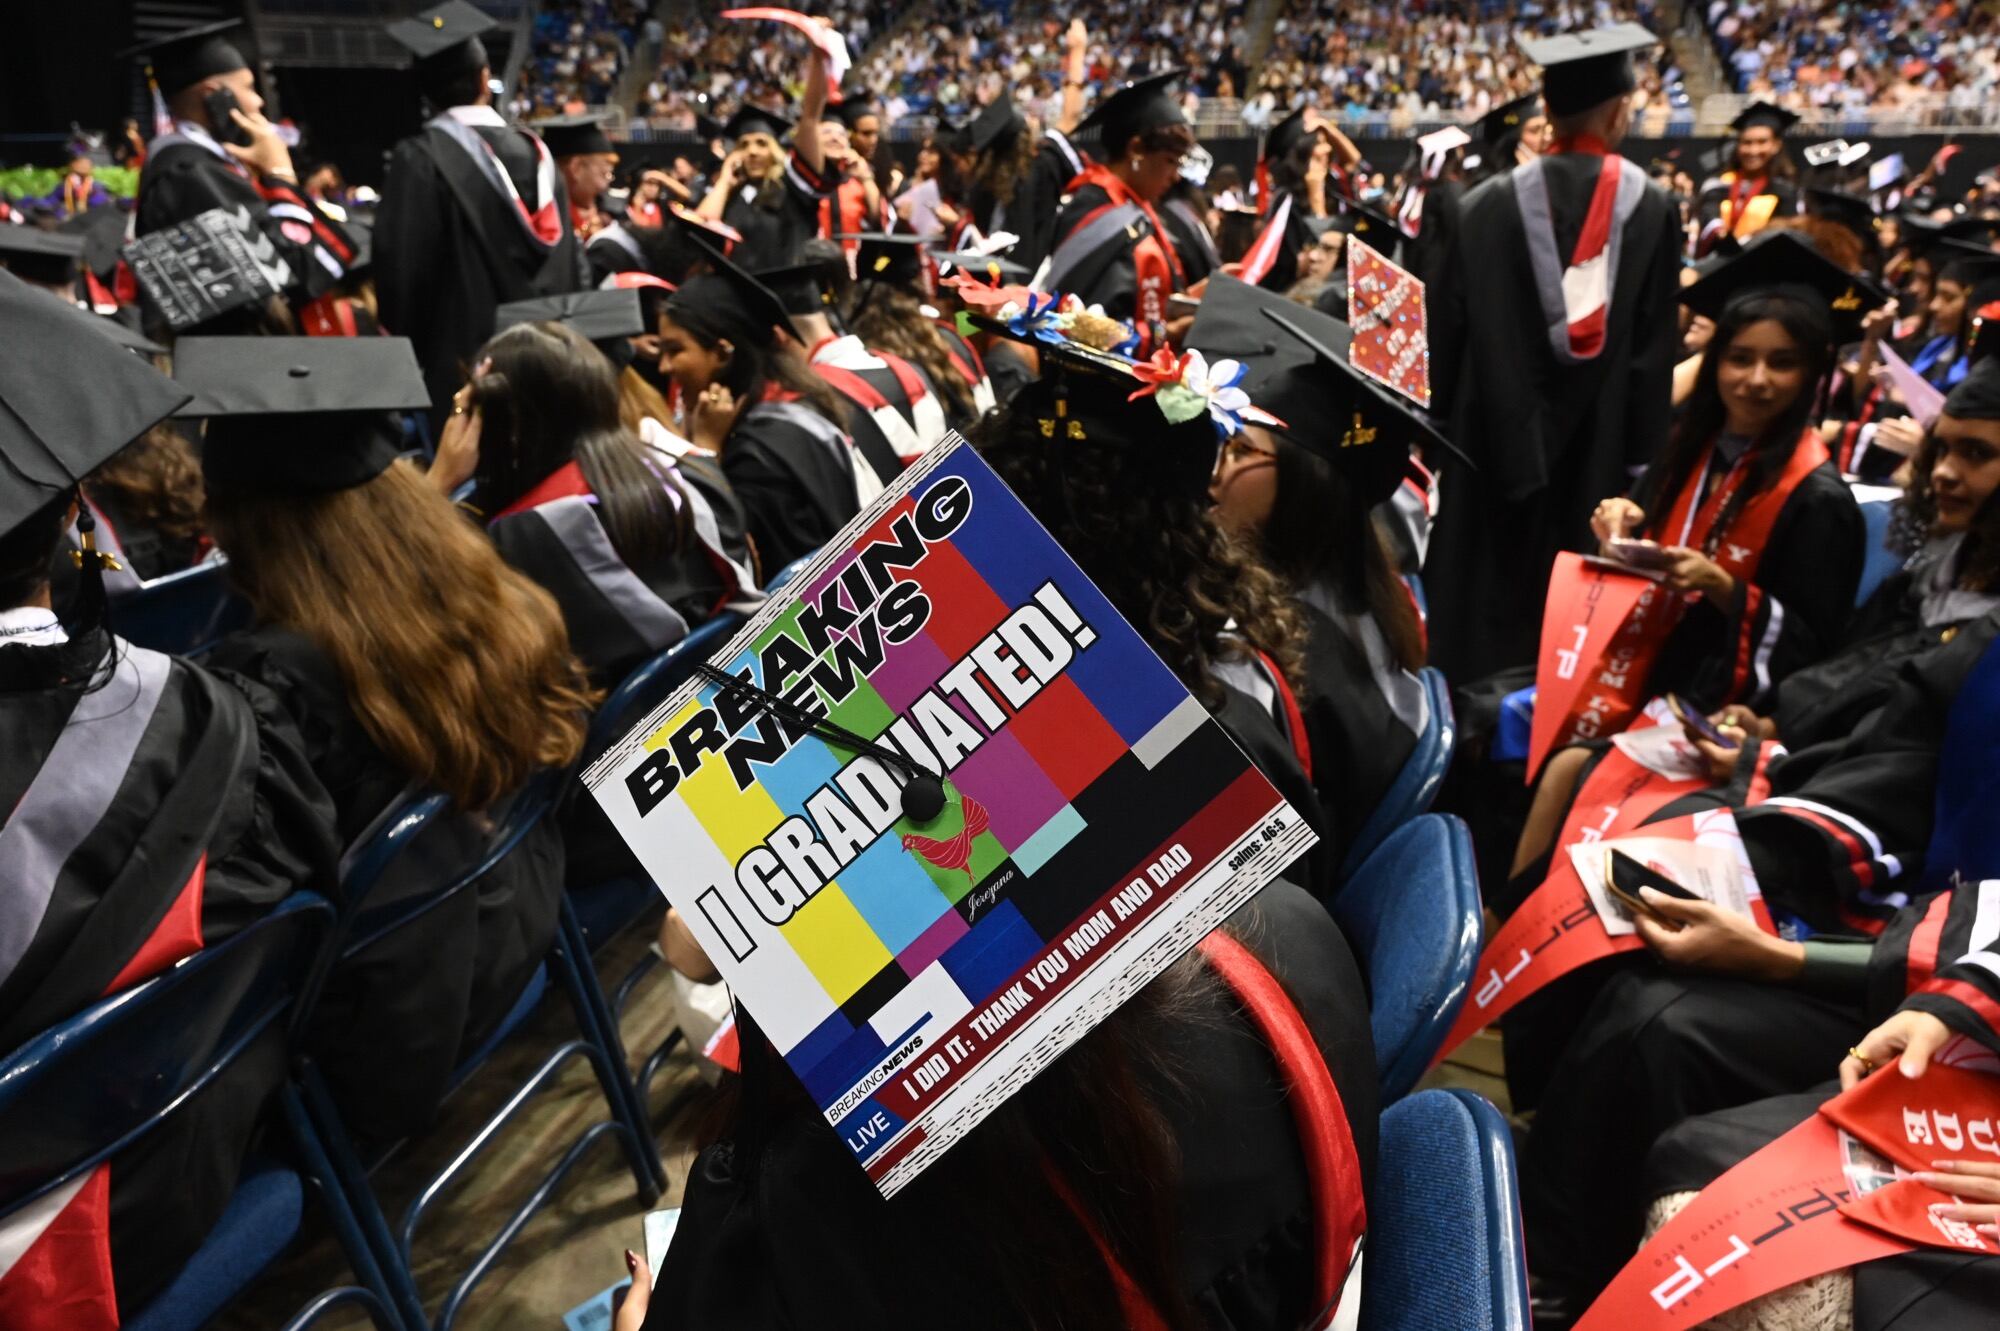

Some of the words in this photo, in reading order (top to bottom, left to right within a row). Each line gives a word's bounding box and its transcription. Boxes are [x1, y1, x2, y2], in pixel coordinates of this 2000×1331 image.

[1142, 275, 1161, 322] MAGN
[623, 474, 975, 818] BREAKING
[722, 578, 931, 792] NEWS
[1228, 839, 1263, 871] salms:
[1261, 818, 1286, 842] 46:5
[695, 885, 757, 962] I
[968, 869, 1014, 922] Jerezana
[902, 1079, 920, 1101] I
[913, 1050, 950, 1092] DID
[948, 1033, 976, 1064] IT:
[968, 981, 1036, 1040] THANK
[1025, 949, 1069, 992] YOU
[1060, 917, 1118, 963] MOM
[1110, 882, 1154, 926] AND
[1145, 843, 1192, 889] DAD
[847, 1110, 891, 1154] LIVE
